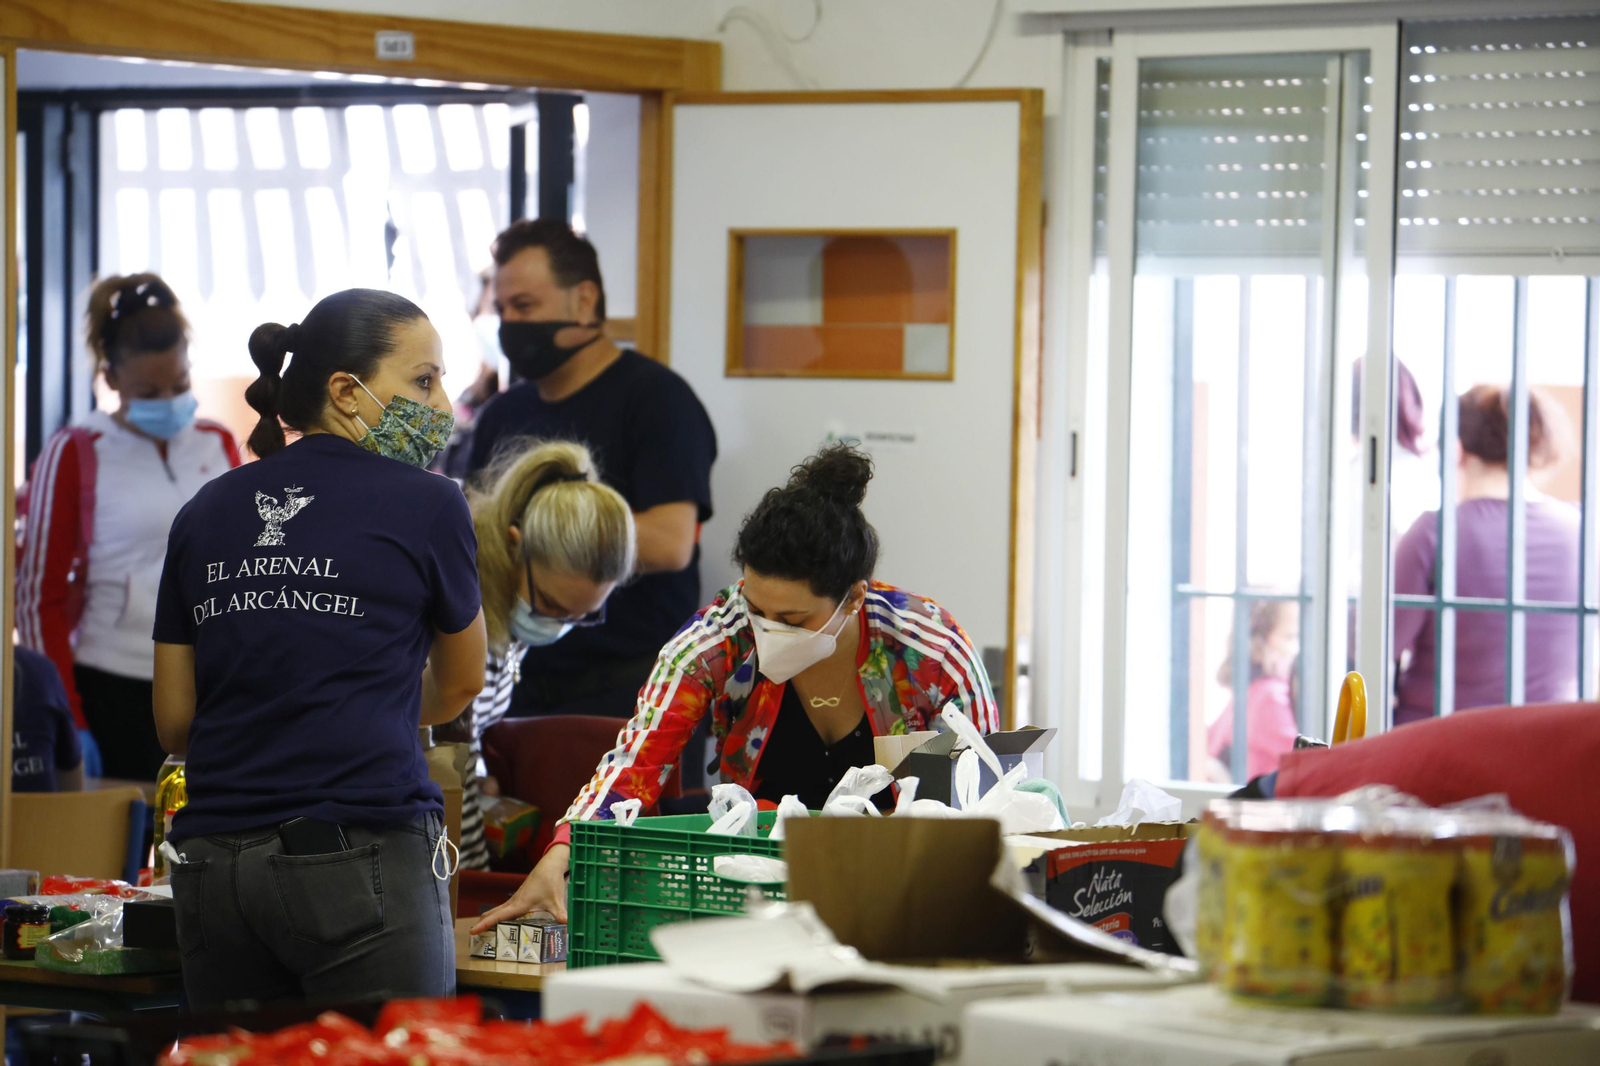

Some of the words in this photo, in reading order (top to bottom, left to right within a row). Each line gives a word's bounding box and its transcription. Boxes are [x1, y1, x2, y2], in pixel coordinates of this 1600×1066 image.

[206, 561, 230, 584] EL
[235, 556, 340, 579] ARENAL
[226, 585, 365, 617] ARCÁNGEL
[1087, 865, 1123, 898] Nata
[1069, 888, 1133, 918] Selección
